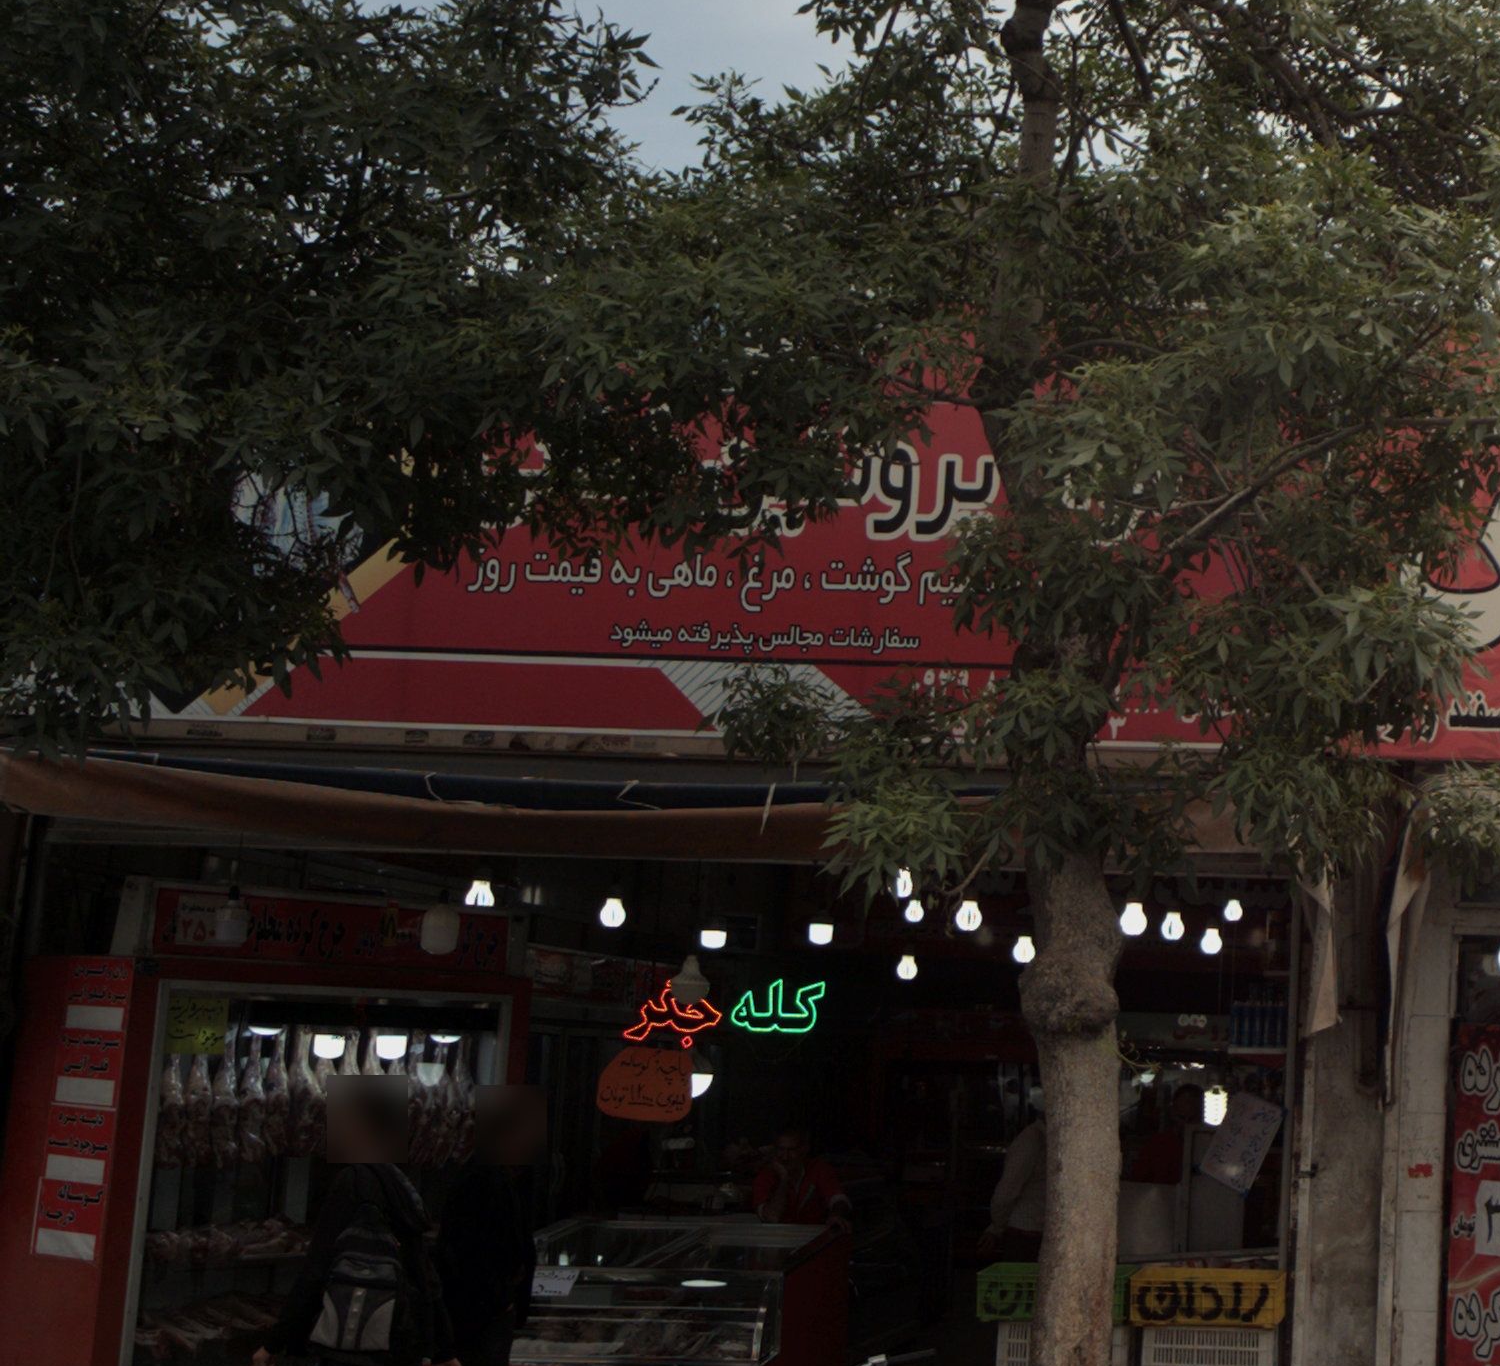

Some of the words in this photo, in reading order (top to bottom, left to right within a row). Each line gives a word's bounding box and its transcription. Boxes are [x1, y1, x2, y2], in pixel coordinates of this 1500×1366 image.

[467, 546, 517, 593] روز
[524, 549, 602, 595] قیمت
[609, 558, 642, 597] به
[647, 553, 718, 598] ماهی
[739, 552, 796, 613] مرغ
[821, 551, 911, 605] گوشت
[609, 619, 673, 648] میشود
[678, 621, 754, 654] پذیرفته
[757, 624, 824, 652] مجالس
[828, 627, 920, 654] سفارشات
[730, 977, 827, 1034] کله
